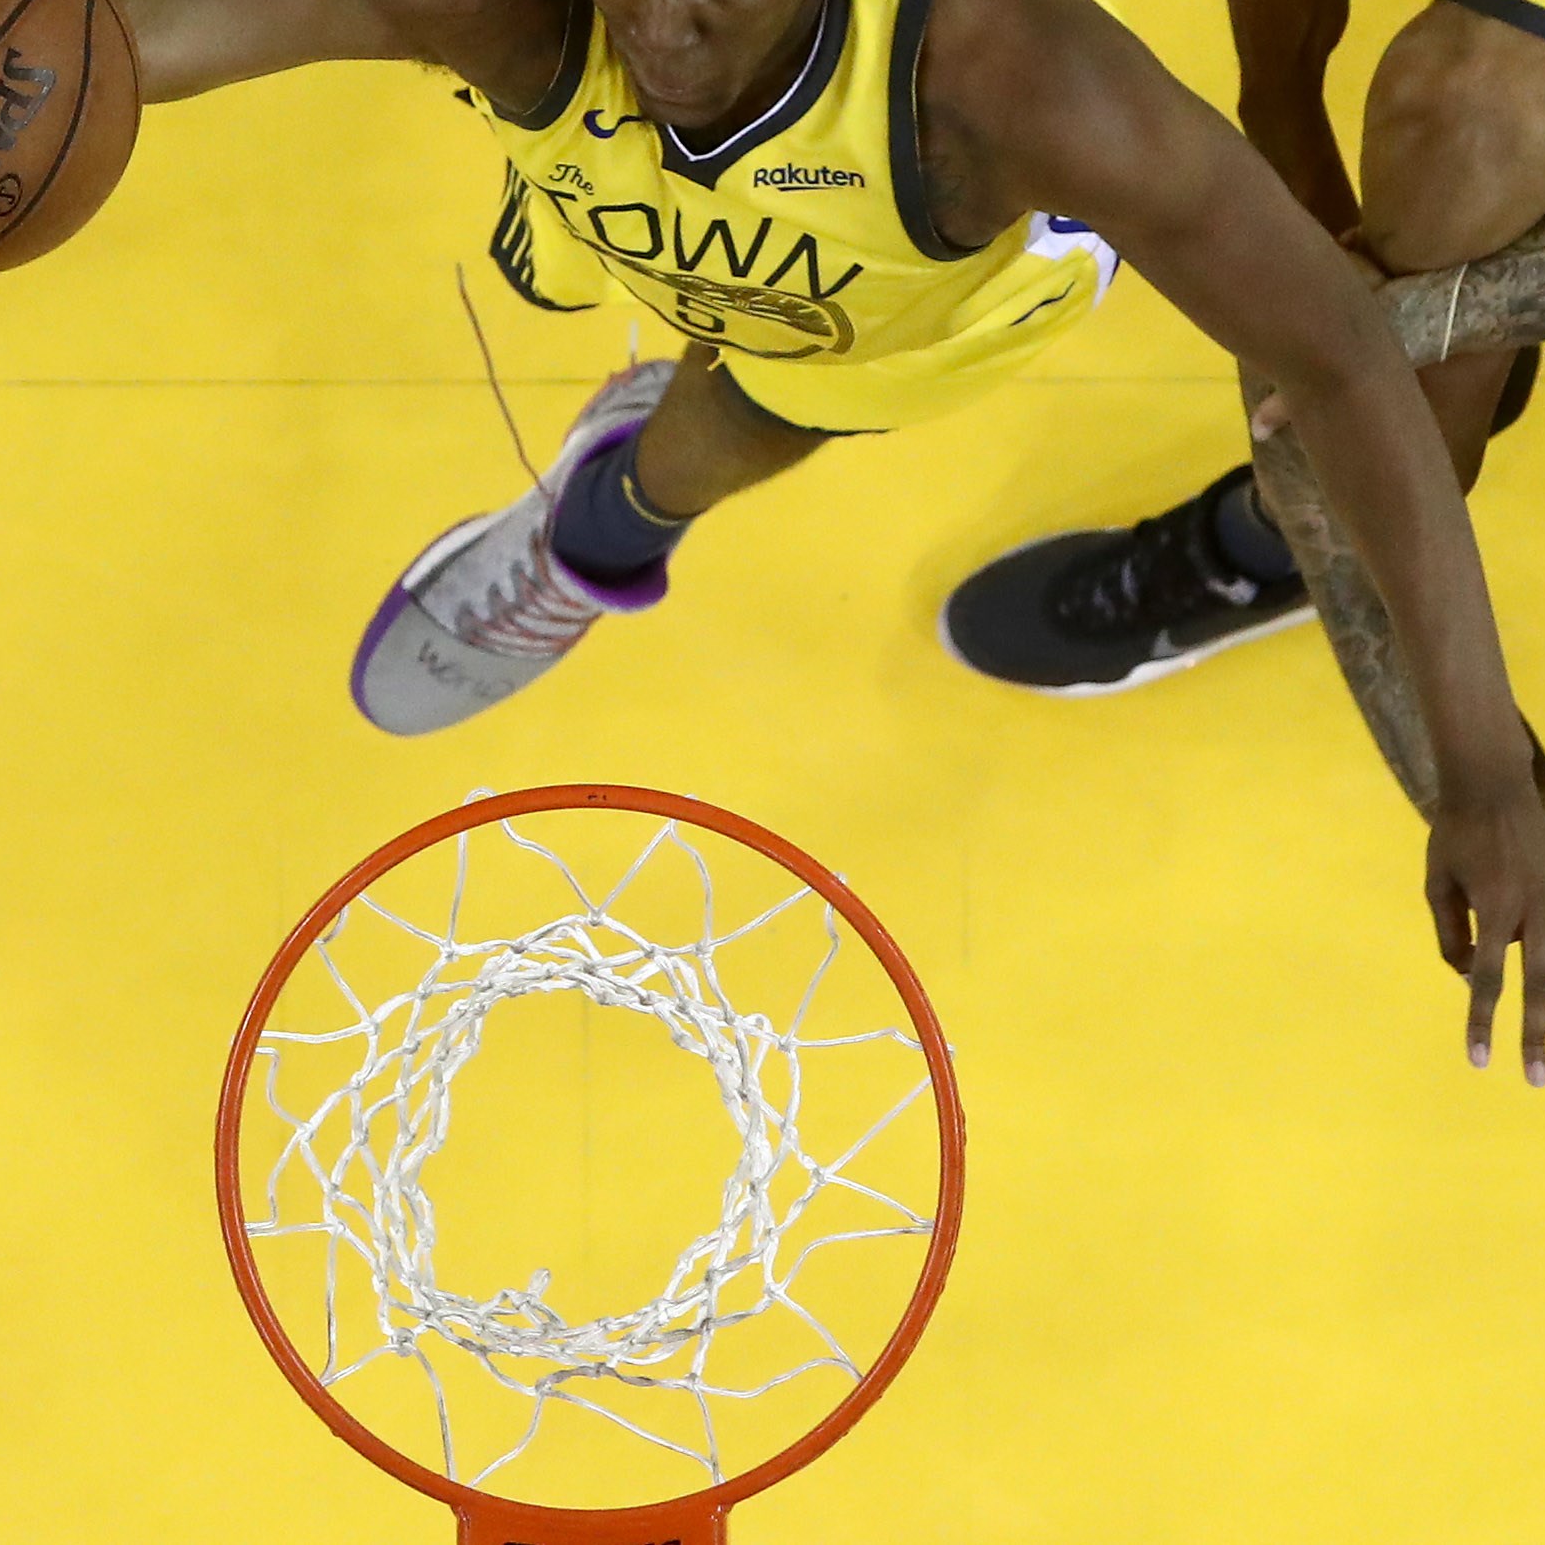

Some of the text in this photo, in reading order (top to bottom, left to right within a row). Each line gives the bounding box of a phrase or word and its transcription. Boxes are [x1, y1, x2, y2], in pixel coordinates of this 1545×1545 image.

[548, 162, 595, 196] The
[753, 163, 866, 192] Rakuten
[535, 182, 865, 300] TOWN
